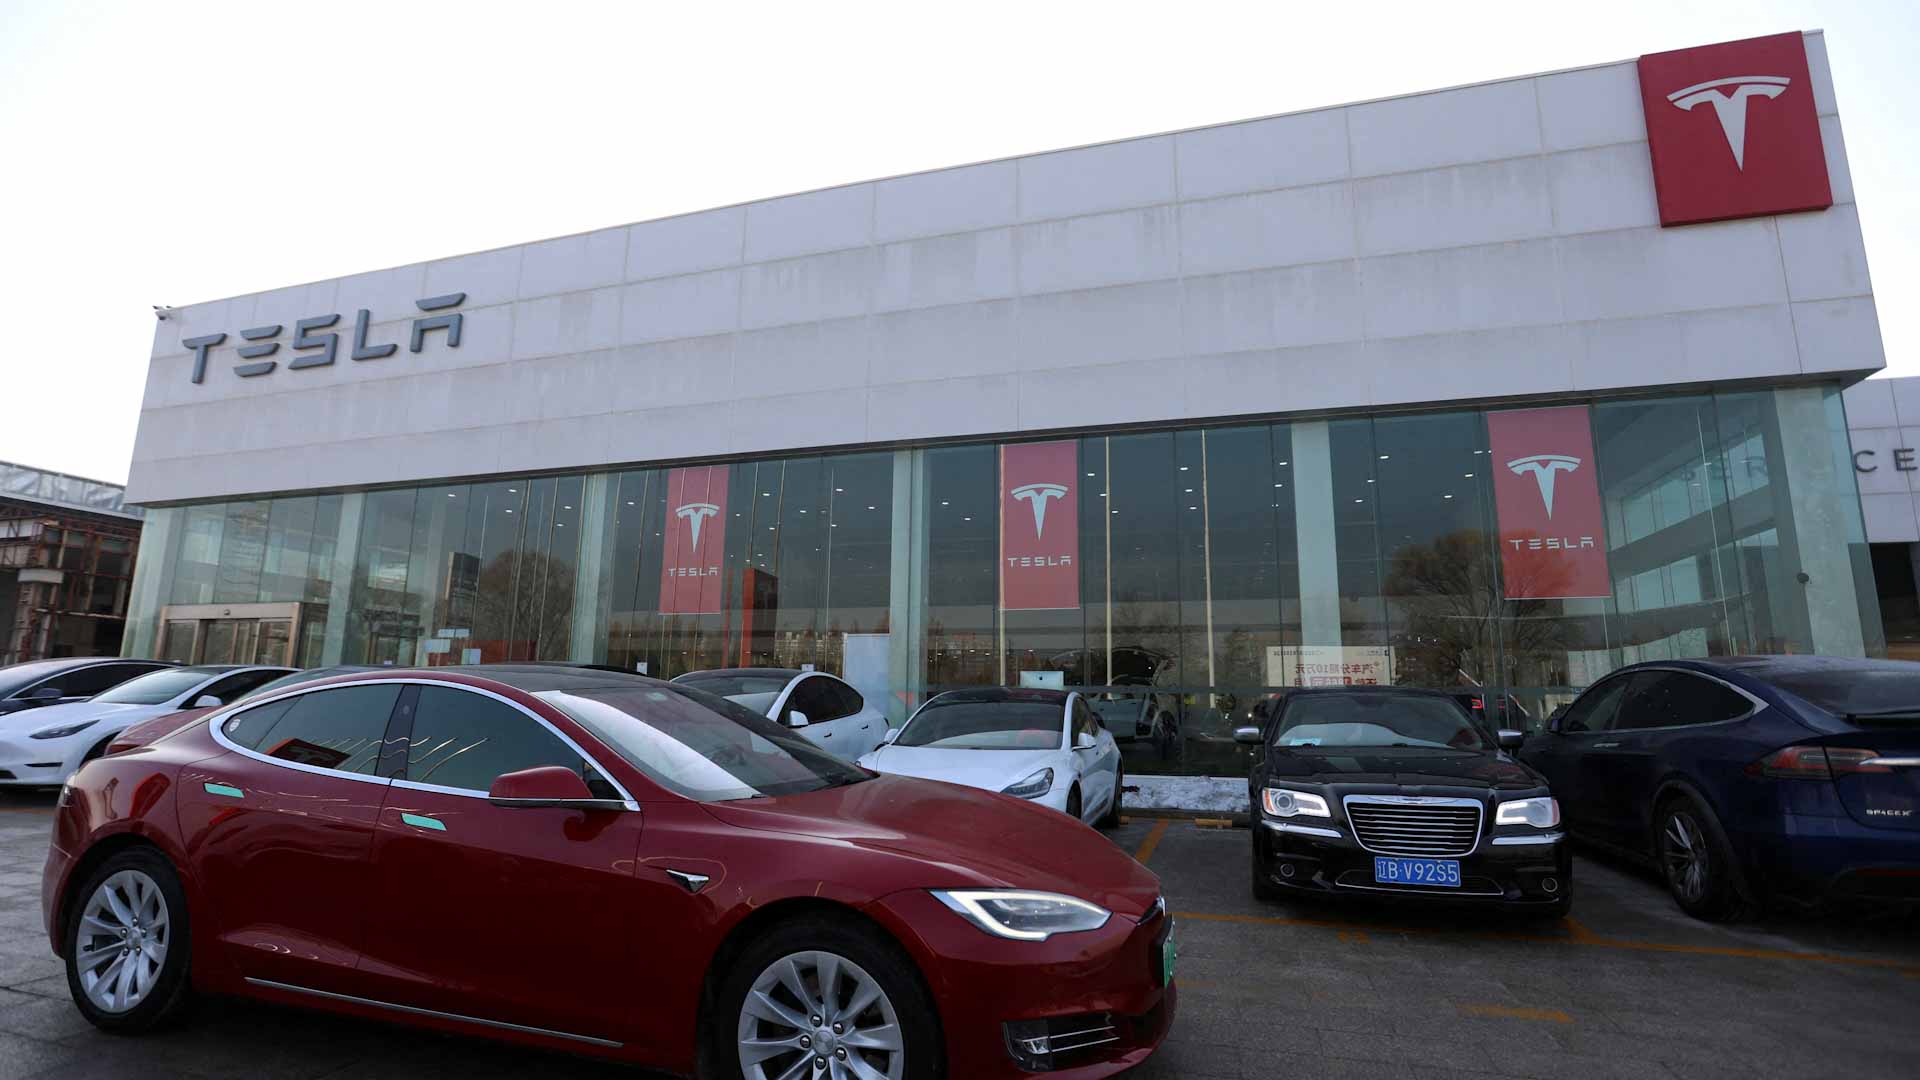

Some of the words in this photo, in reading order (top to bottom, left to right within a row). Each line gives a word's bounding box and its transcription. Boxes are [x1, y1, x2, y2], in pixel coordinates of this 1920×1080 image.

[182, 292, 467, 384] TESLA
[1508, 536, 1595, 551] TESLA
[1007, 555, 1072, 568] TESLA
[668, 567, 719, 577] TESLA
